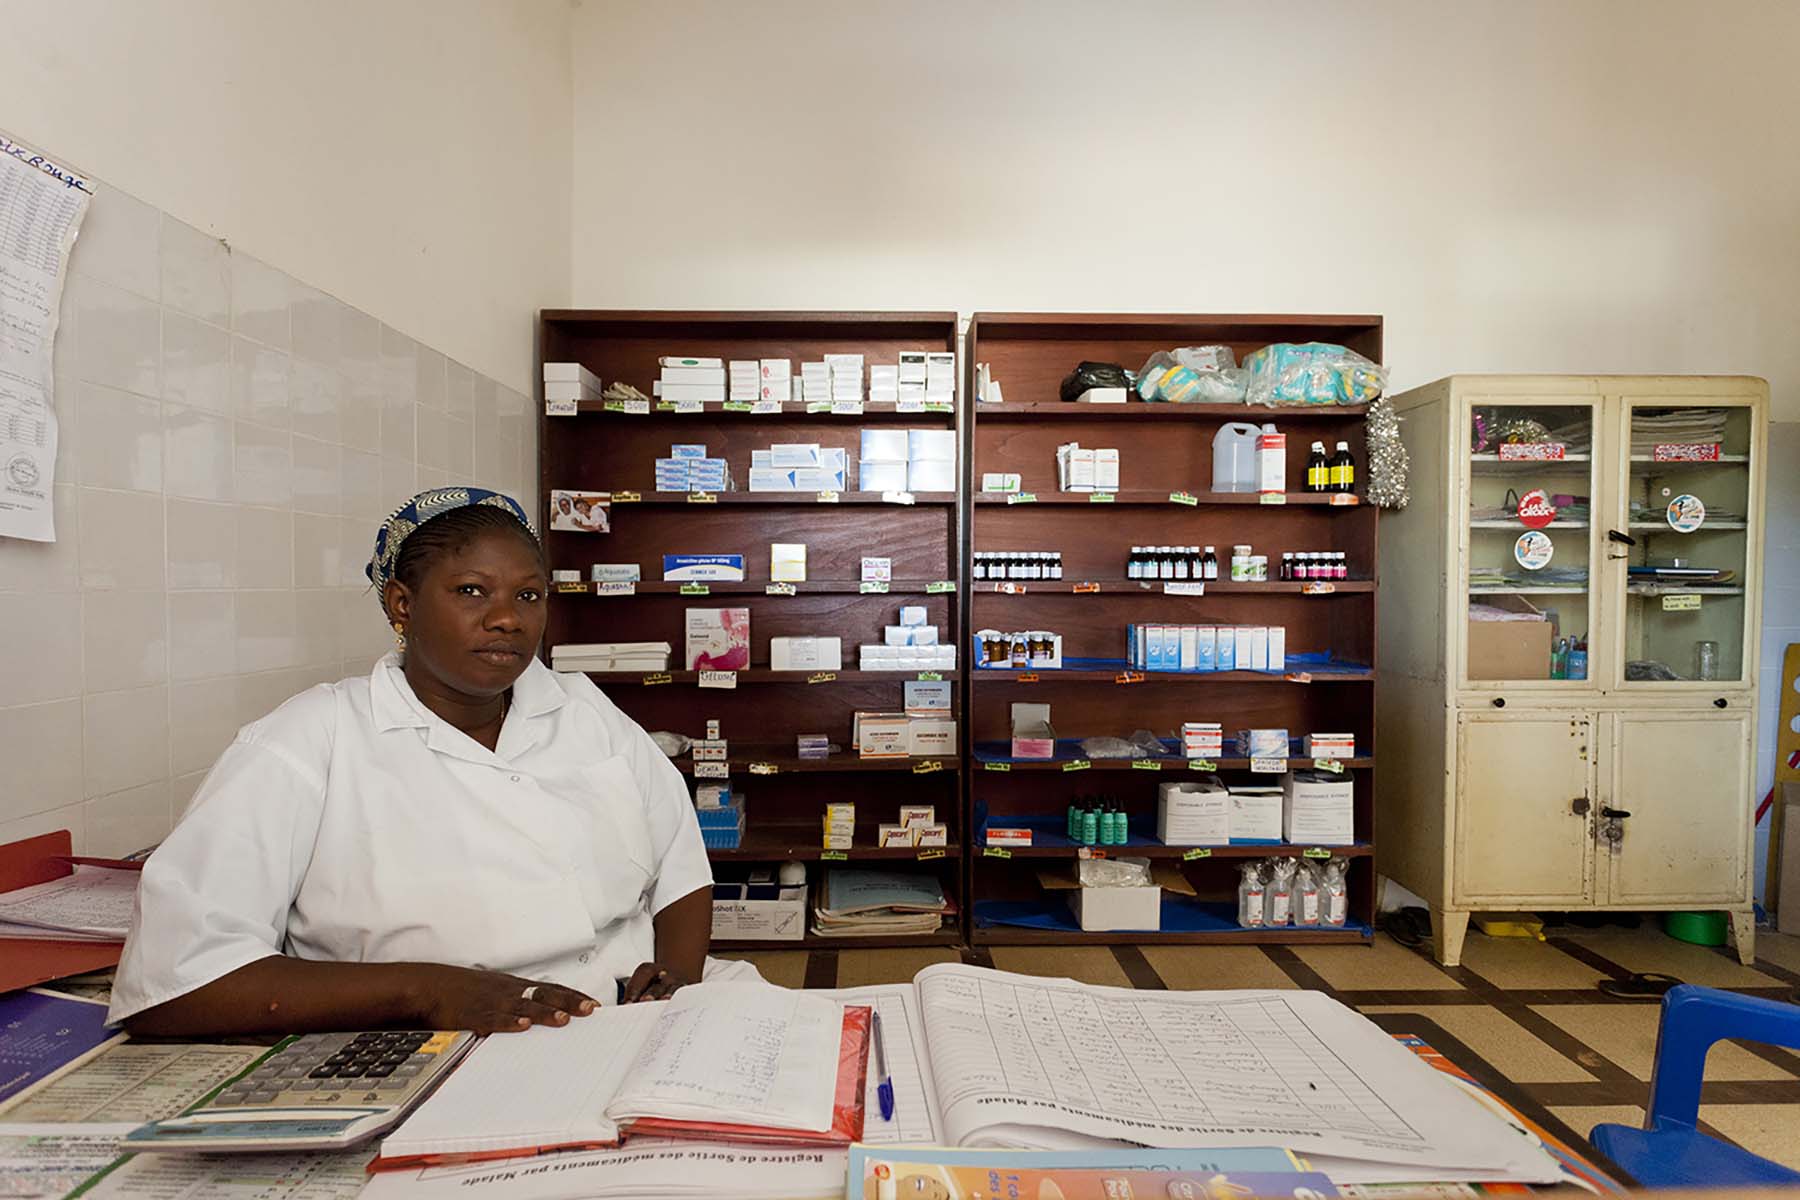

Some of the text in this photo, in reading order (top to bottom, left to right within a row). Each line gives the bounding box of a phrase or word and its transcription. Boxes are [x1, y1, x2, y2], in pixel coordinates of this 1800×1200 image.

[28, 156, 94, 196] Rouge
[976, 1097, 1028, 1106] Malade
[1033, 1100, 1056, 1109] par
[1061, 1105, 1156, 1129] médicaments
[1160, 1124, 1184, 1132] des
[1189, 1126, 1235, 1134] Sortie
[1259, 1128, 1322, 1137] Registre
[461, 1151, 824, 1187] Registre de Sortie des médicaments par Malade
